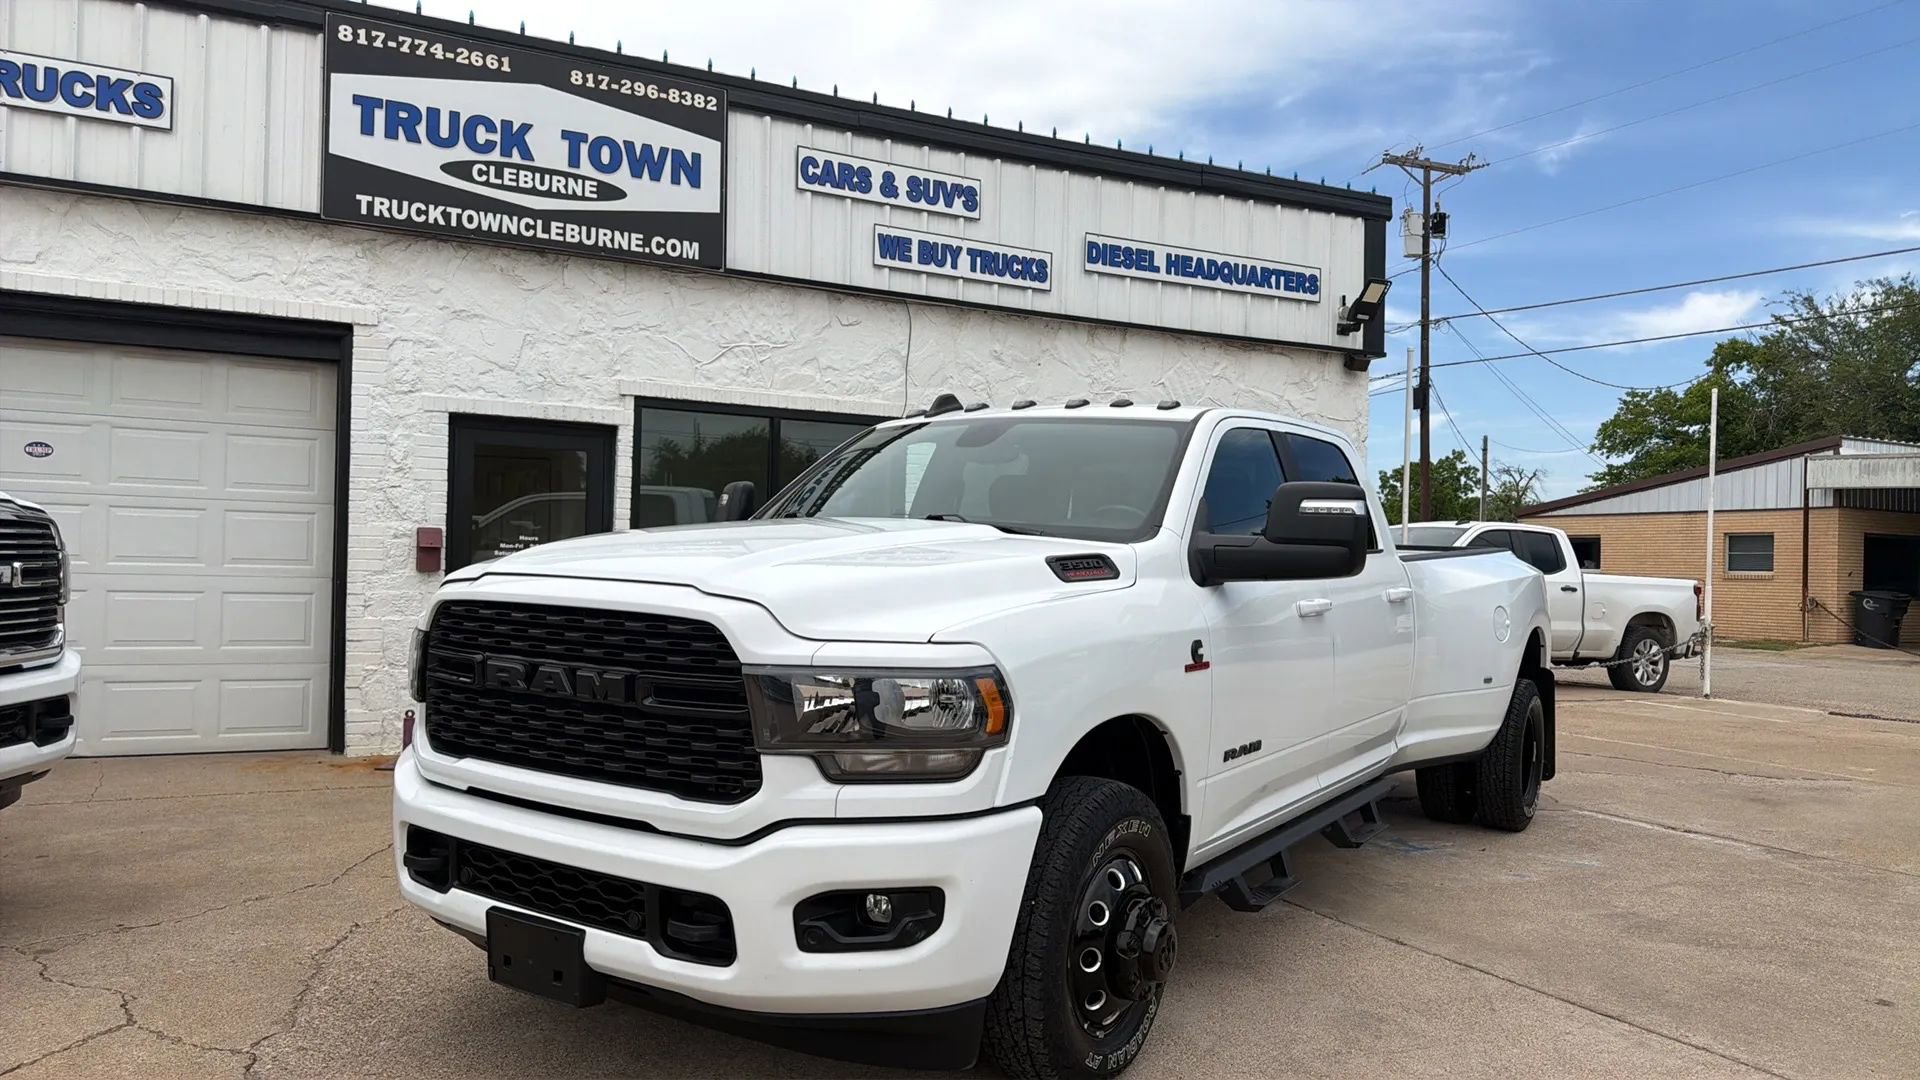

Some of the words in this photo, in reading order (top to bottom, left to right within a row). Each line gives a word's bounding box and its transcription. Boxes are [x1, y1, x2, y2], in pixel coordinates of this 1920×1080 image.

[337, 24, 512, 72] 817-774-2661
[570, 70, 718, 111] 817-296-8382
[353, 94, 535, 161] TRUCK
[561, 129, 702, 189] TOWN
[472, 164, 598, 198] CLEBURNE
[800, 156, 873, 194] CARS
[879, 171, 900, 200] &
[906, 175, 979, 213] SUV'S
[355, 194, 700, 260] TRUCKTOWNCLEBURNE.COM
[877, 233, 913, 263] WE
[917, 240, 963, 270] BUY
[966, 248, 1049, 284] TRUCKS
[1087, 241, 1160, 274] DIESEL
[1165, 253, 1319, 295] HEADQUARTERS
[1059, 559, 1105, 571] 3500
[486, 656, 627, 702] RAM
[1223, 739, 1262, 763] RAM
[1092, 819, 1152, 868] NEXEN
